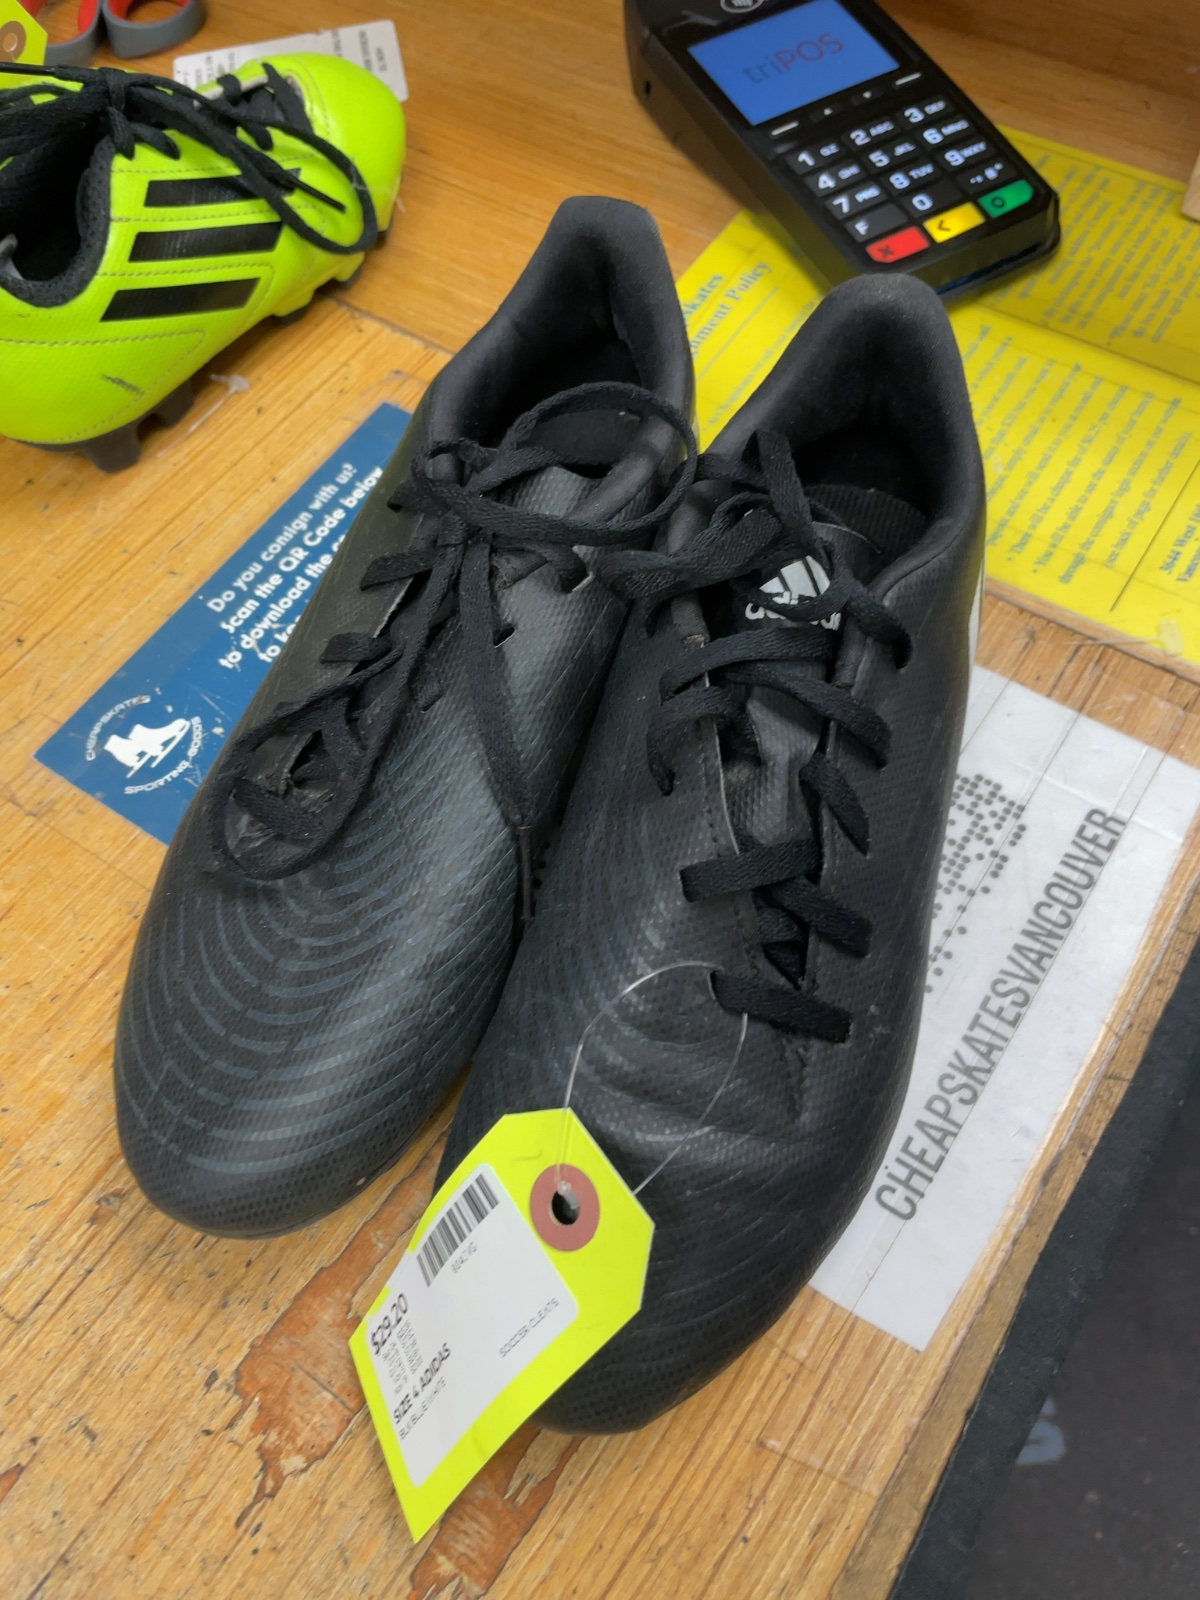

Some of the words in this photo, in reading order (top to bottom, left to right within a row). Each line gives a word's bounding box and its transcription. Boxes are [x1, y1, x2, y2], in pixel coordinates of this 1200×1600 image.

[742, 32, 845, 85] triPOS
[904, 107, 923, 122] 3
[924, 101, 944, 113] DEF
[850, 129, 869, 145] 2
[869, 122, 893, 135] ABC
[923, 128, 942, 143] 6
[798, 152, 814, 165] 1
[869, 151, 889, 166] 5
[944, 150, 964, 165] 9
[818, 173, 835, 188] 4
[889, 173, 909, 188] 8
[909, 164, 932, 178] TUV
[832, 195, 849, 212] 7
[912, 194, 932, 210] 0
[724, 261, 771, 300] Policy
[207, 590, 235, 612] Do
[233, 562, 262, 590] you
[261, 512, 312, 561] consign
[309, 484, 338, 509] with
[335, 463, 356, 483] us?
[1174, 524, 1196, 547] West
[220, 599, 259, 633] Scan
[254, 574, 282, 598] the
[279, 547, 308, 571] QR
[303, 508, 345, 546] Code
[339, 467, 382, 507] below
[218, 647, 243, 671] to
[240, 576, 310, 649] download
[304, 554, 332, 577] the
[257, 645, 280, 662] to
[188, 716, 203, 757] GOODS
[124, 762, 190, 795] SPORTING
[875, 808, 1128, 1220] CHEAPSKATESVANCOUVER
[370, 1293, 408, 1355] $29.20
[499, 1325, 529, 1357] SOCCER
[393, 1395, 412, 1423] SIZE
[412, 1386, 421, 1398] 4
[420, 1342, 450, 1388] ADIDAS
